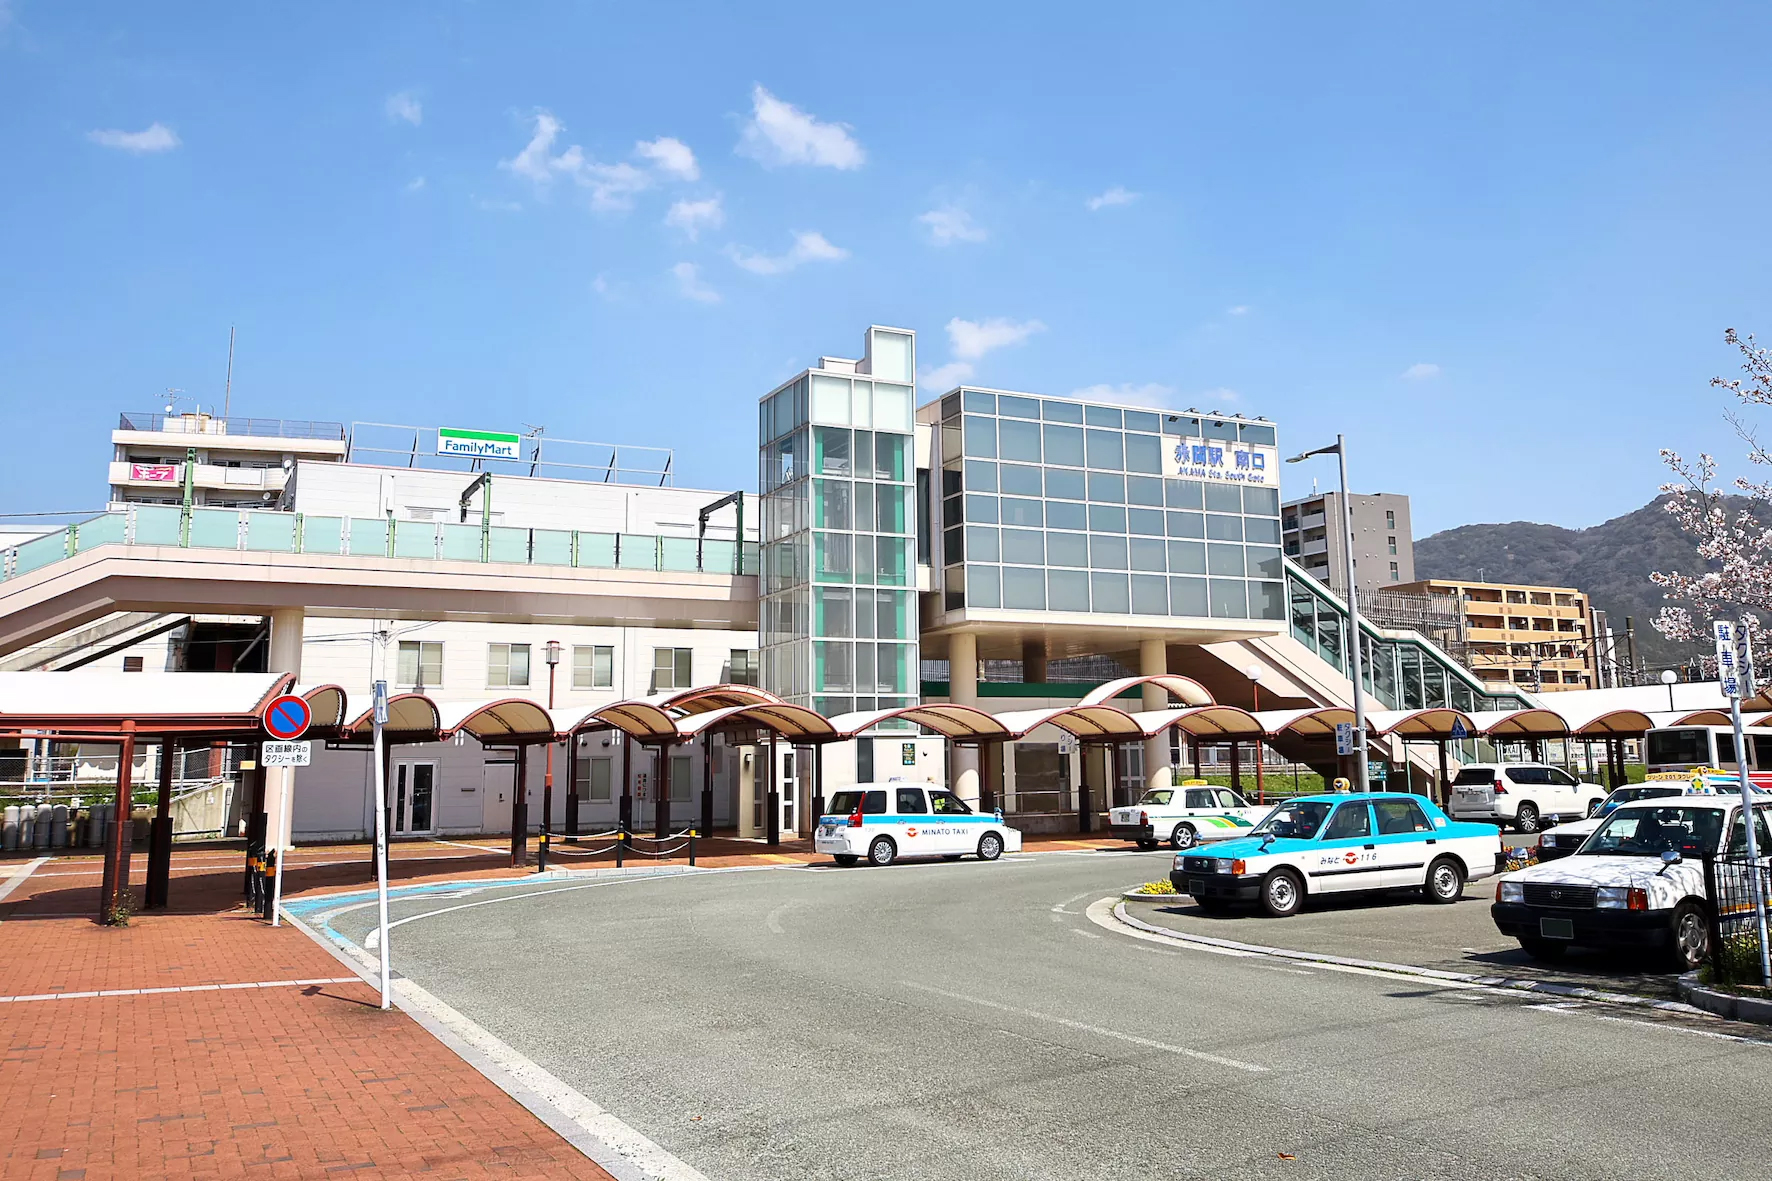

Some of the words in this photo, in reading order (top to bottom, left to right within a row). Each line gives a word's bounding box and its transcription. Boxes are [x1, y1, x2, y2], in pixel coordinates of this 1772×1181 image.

[445, 440, 512, 455] FamilyMart
[1174, 443, 1223, 467] 赤間駅
[1234, 450, 1265, 470] 南口
[1178, 466, 1206, 477] AKAMA
[1225, 471, 1245, 481] South
[1247, 473, 1265, 483] Gate
[1717, 625, 1737, 694] 駐車場
[1736, 625, 1749, 693] タクシー
[1344, 723, 1352, 753] タクシー
[265, 744, 308, 753] 区画線内の
[265, 754, 308, 763] タクシーを除く
[922, 828, 951, 836] MINATO
[1320, 856, 1340, 865] みなと
[1361, 852, 1377, 861] 116
